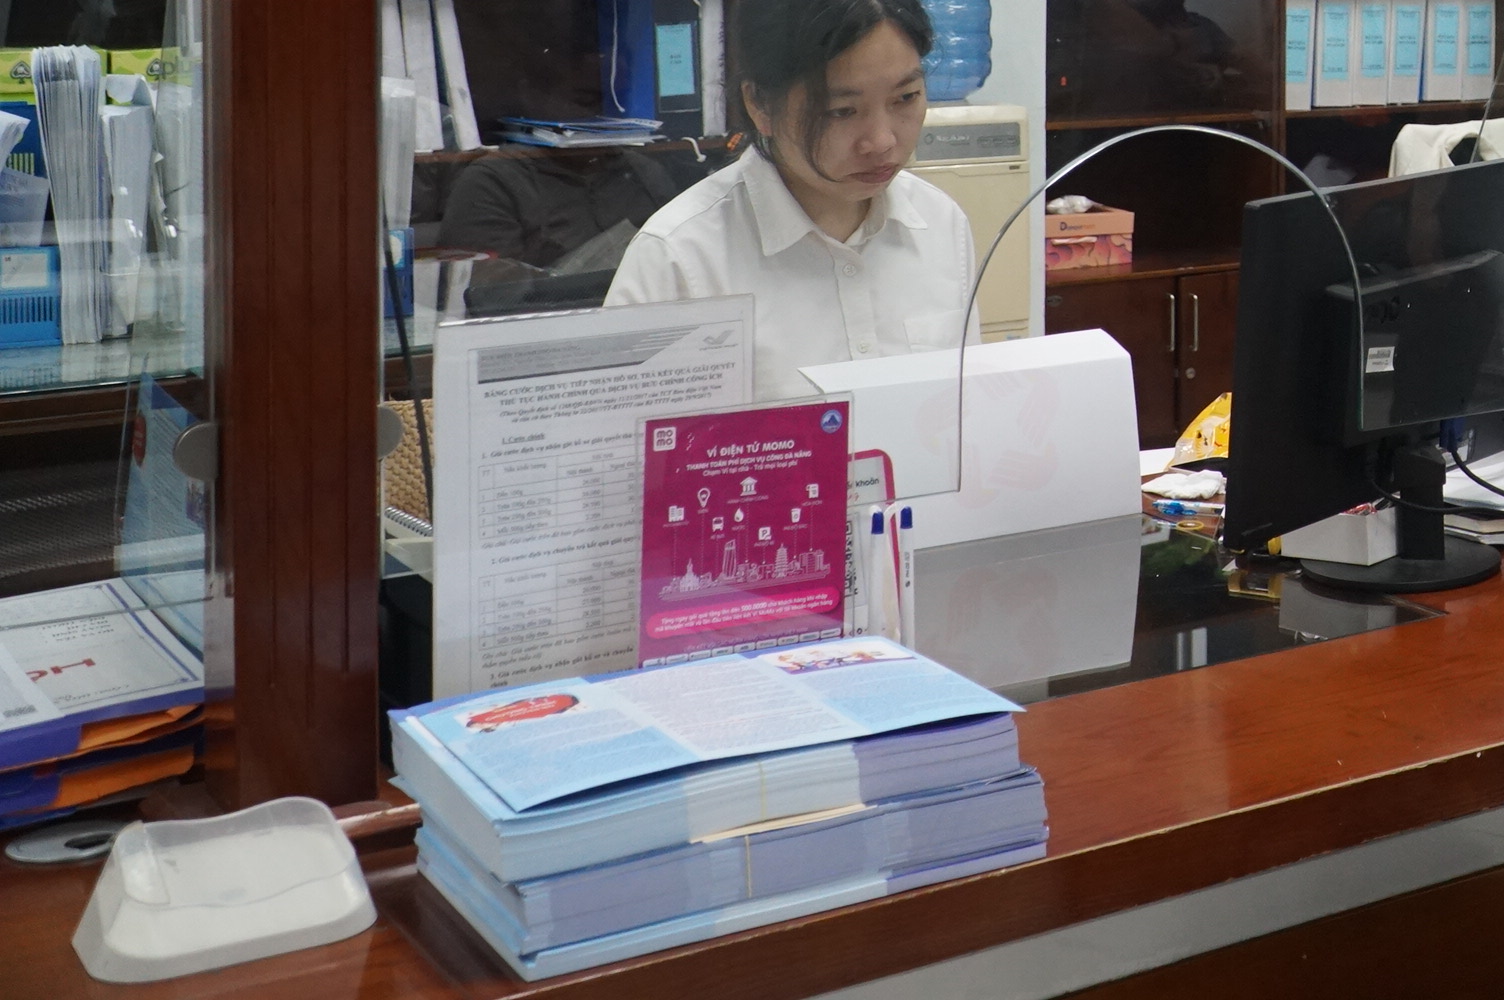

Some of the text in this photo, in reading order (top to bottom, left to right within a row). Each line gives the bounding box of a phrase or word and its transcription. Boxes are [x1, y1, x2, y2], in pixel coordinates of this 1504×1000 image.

[707, 445, 717, 457] VÍ
[720, 444, 743, 458] ĐIỆN
[762, 440, 795, 451] MOMO
